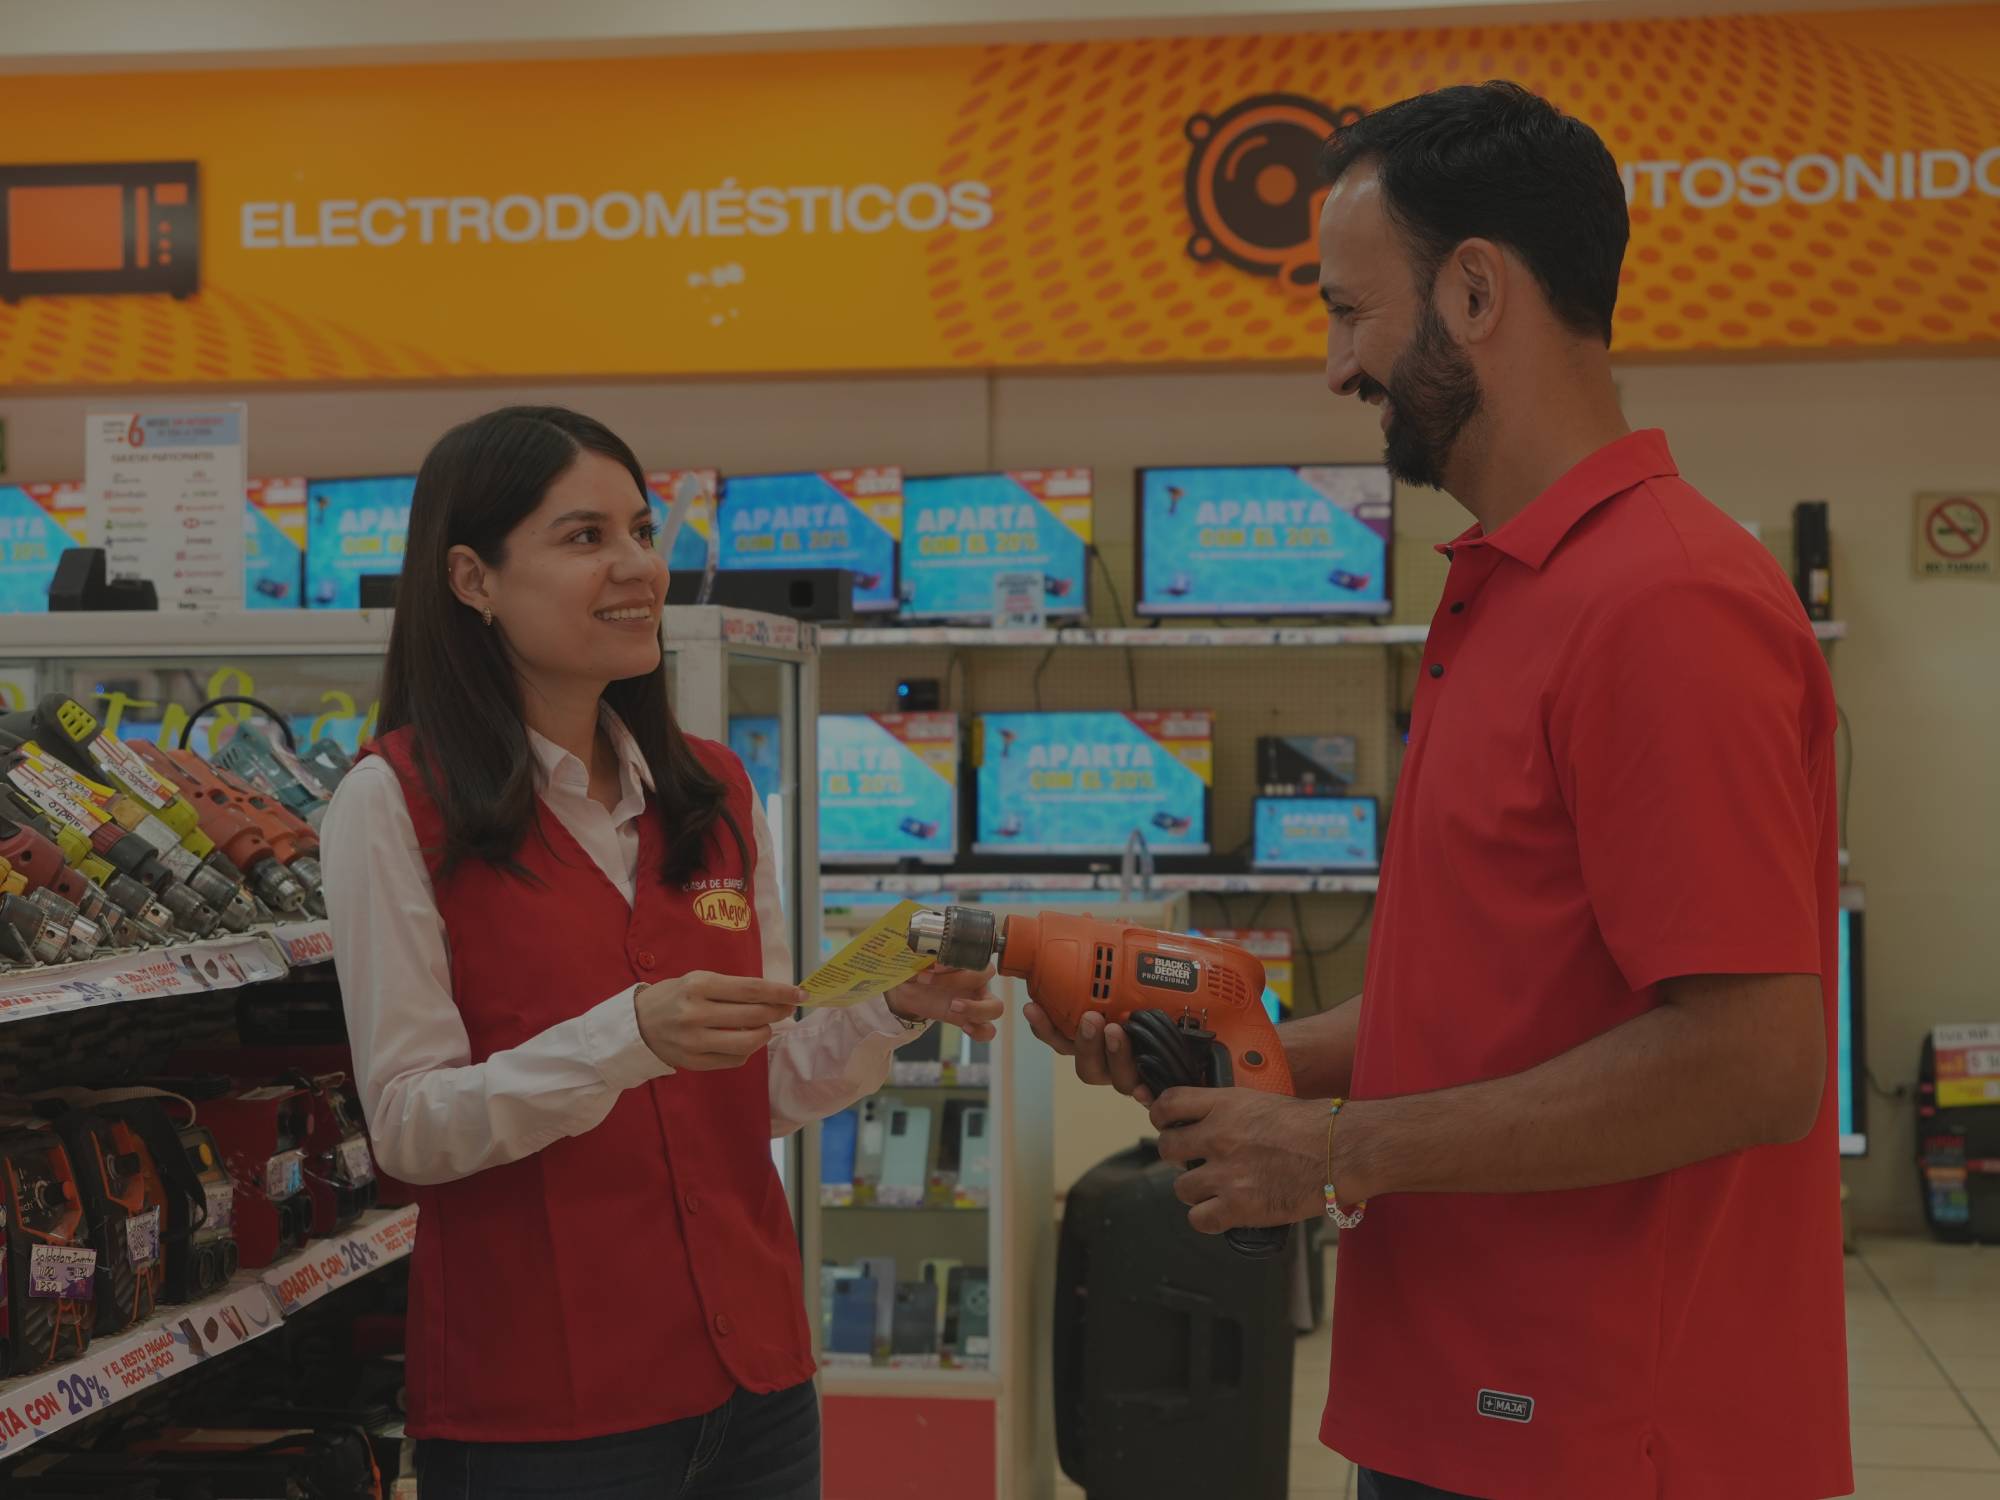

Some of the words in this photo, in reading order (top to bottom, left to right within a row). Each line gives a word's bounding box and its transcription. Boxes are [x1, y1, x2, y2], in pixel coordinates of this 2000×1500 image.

[239, 176, 994, 249] ELECTRODOMÉSTICOS
[127, 412, 145, 448] 6
[732, 503, 849, 532] APARTA
[916, 503, 1038, 533] APARTA
[1195, 500, 1332, 525] APARTA
[1026, 743, 1154, 768] APARTA
[709, 879, 721, 889] DE
[723, 879, 748, 892] EMPE
[695, 899, 717, 921] La
[717, 898, 747, 927] Mejor
[1154, 966, 1191, 980] DECKER
[278, 1263, 323, 1306] APARTA
[320, 1253, 345, 1280] CON
[341, 1240, 379, 1273] 20%
[121, 1367, 146, 1388] POCO
[152, 1350, 175, 1370] POCO
[24, 1392, 61, 1426] CON
[57, 1373, 110, 1416] 20%
[102, 1365, 112, 1379] Y
[110, 1360, 123, 1377] EL
[120, 1347, 146, 1371] RESTO
[1496, 1400, 1524, 1414] MAJA
